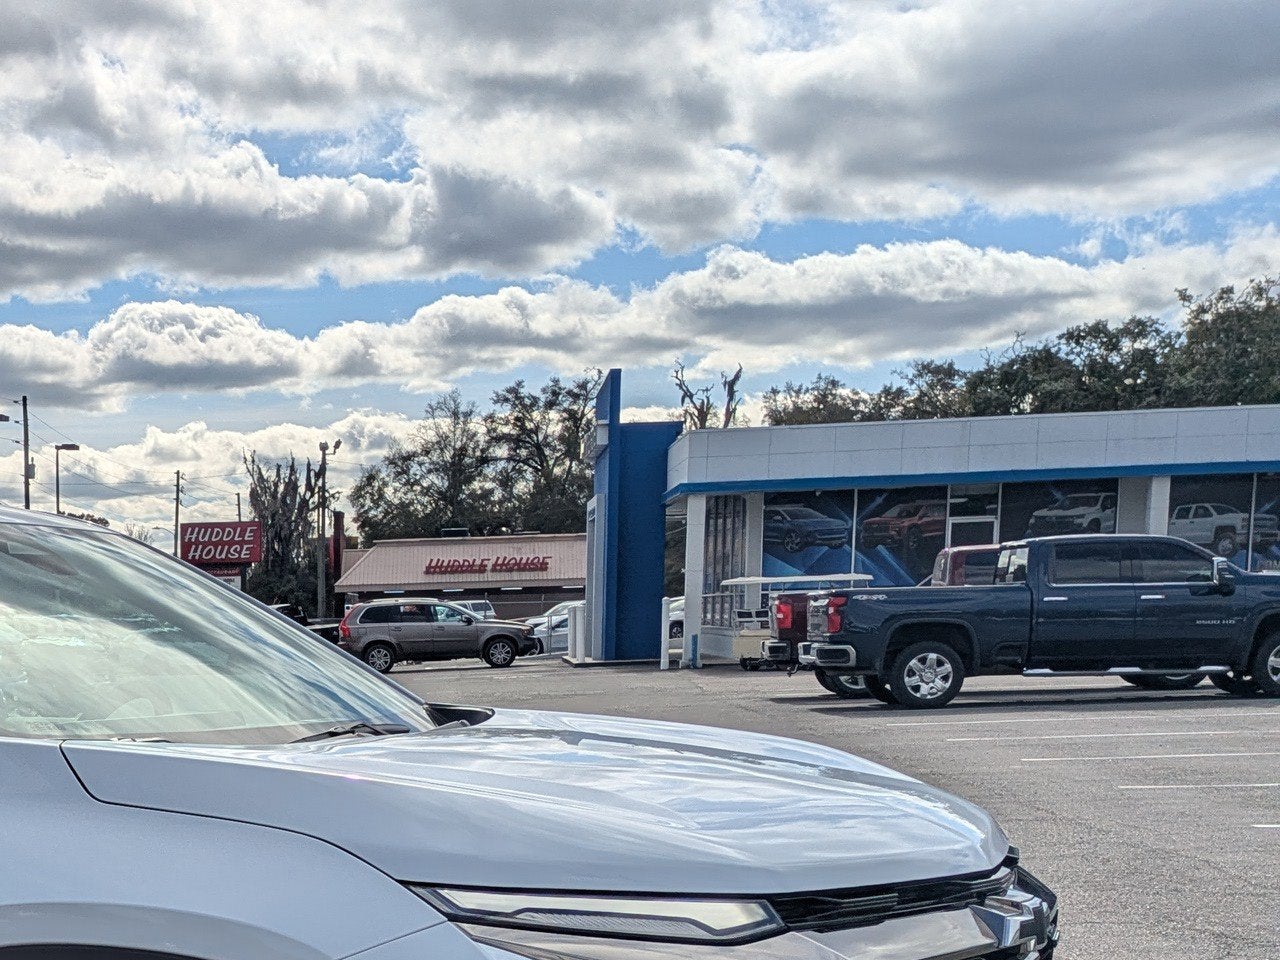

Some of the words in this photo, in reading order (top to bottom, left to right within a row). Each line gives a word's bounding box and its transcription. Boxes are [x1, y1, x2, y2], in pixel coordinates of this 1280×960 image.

[184, 526, 258, 542] HUDDLE
[188, 544, 254, 560] HOUSE
[423, 558, 491, 575] HUDDLE
[489, 556, 552, 573] HOUSE
